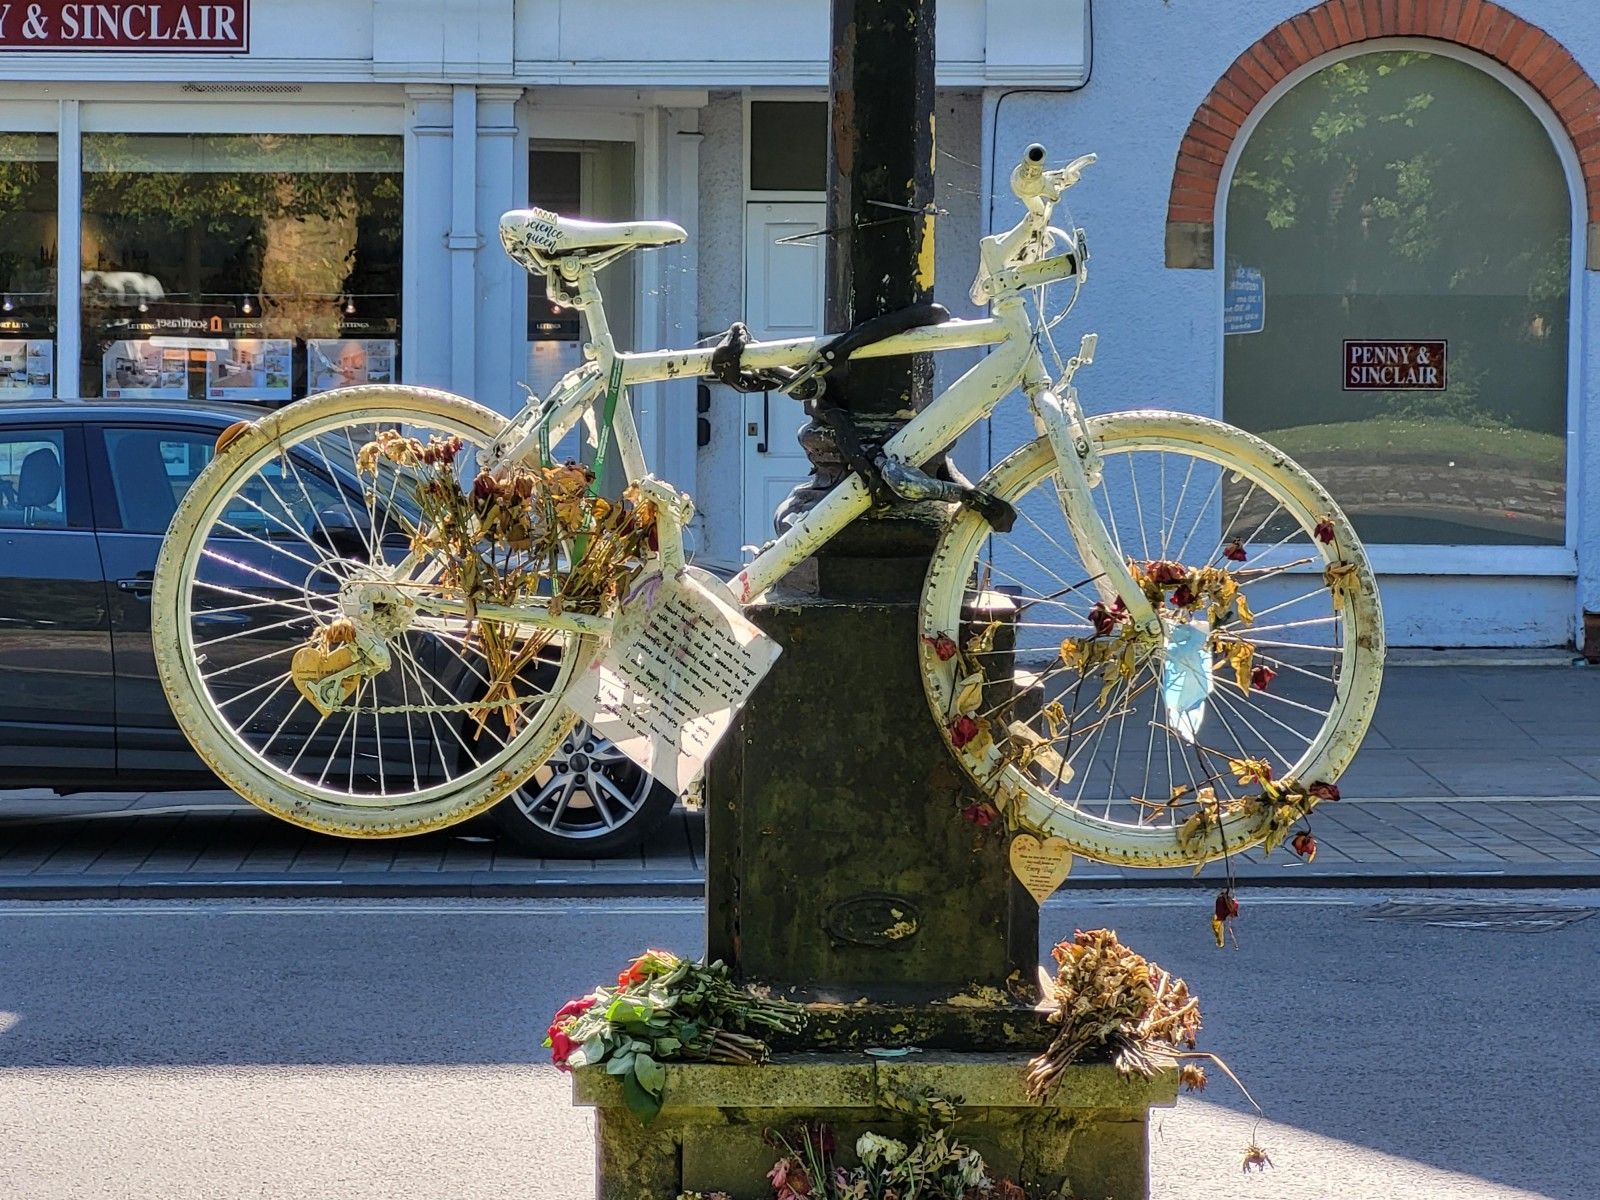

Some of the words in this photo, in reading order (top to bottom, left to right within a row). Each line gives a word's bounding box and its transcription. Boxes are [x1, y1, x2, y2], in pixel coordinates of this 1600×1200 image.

[22, 3, 49, 39] &
[60, 4, 238, 40] SINCLAIR
[525, 232, 558, 253] queen
[1351, 346, 1413, 364] PENNY
[1416, 345, 1431, 365] &
[1351, 366, 1438, 384] SINCLAIR
[677, 599, 696, 614] never
[697, 612, 714, 628] knew
[654, 654, 666, 665] but
